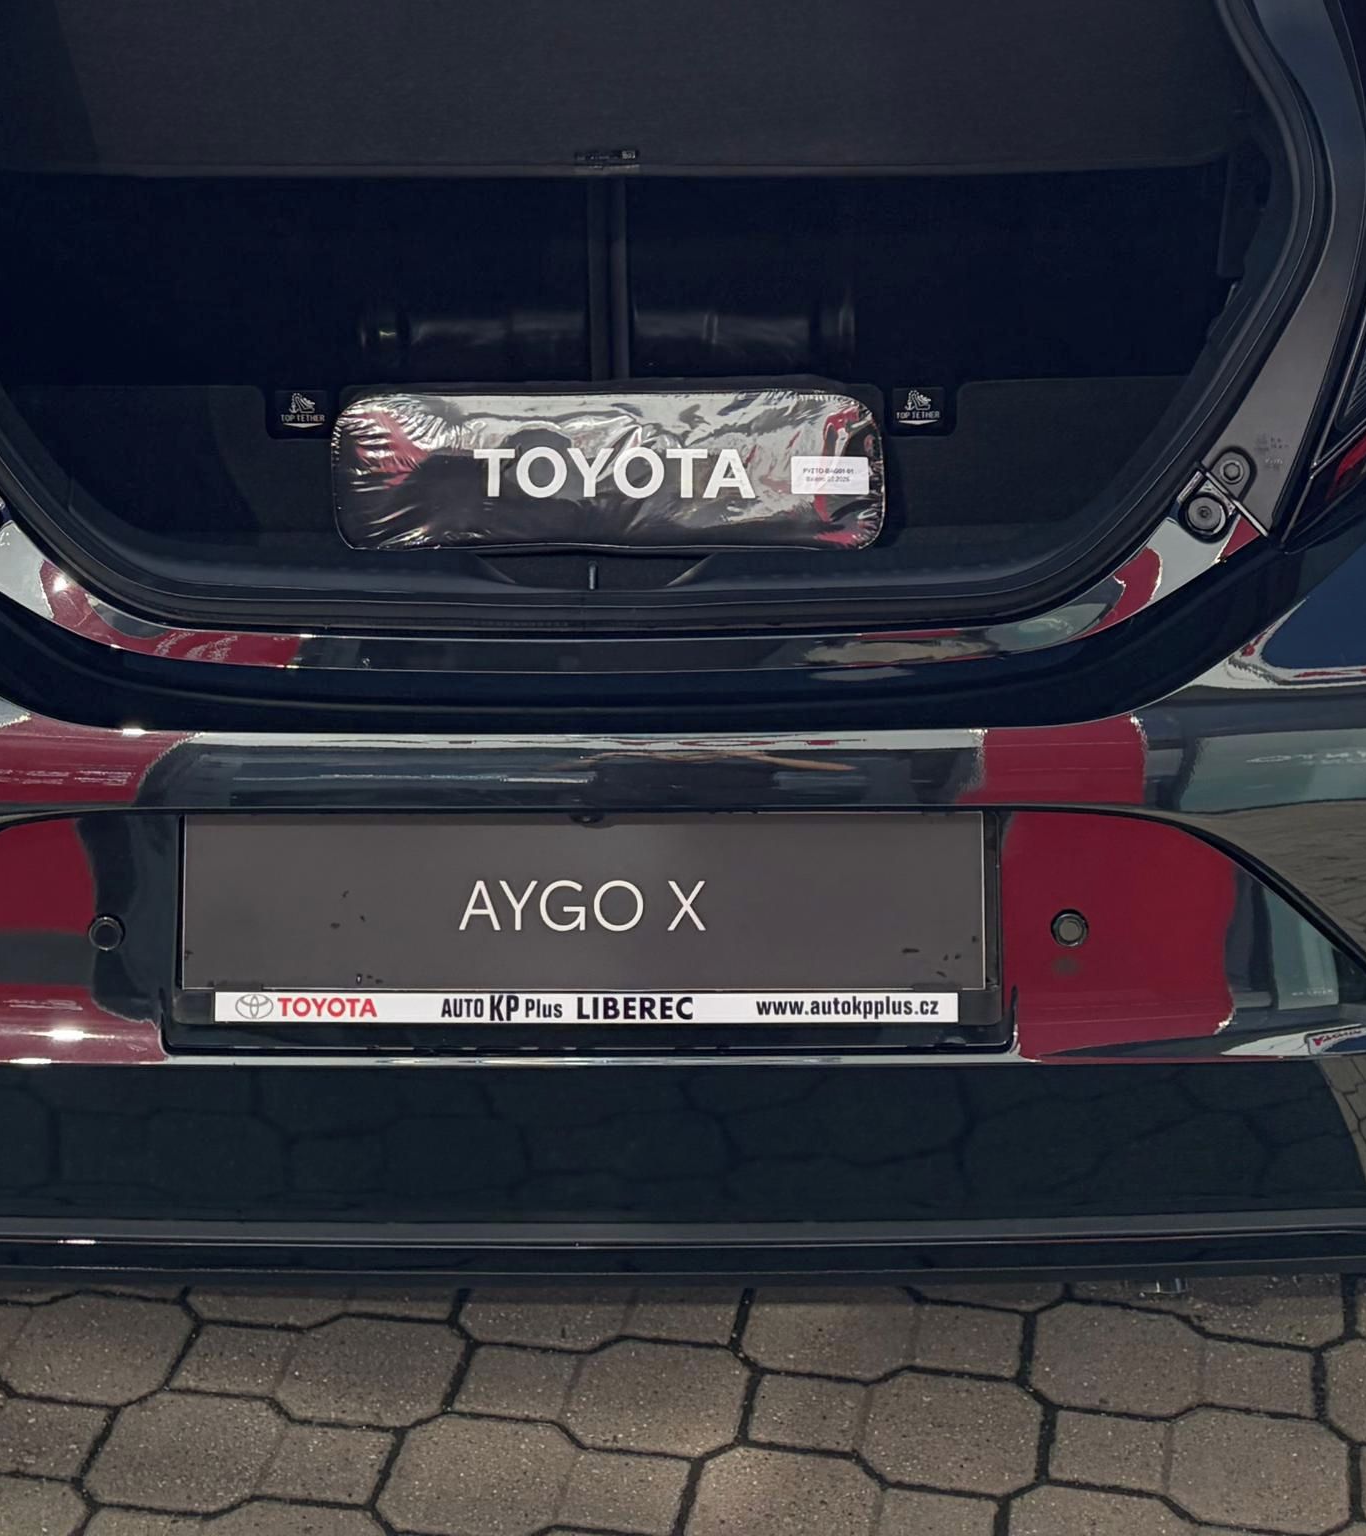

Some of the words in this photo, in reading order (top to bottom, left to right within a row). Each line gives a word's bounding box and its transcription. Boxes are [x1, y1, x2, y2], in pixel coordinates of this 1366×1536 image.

[280, 414, 295, 422] TOP
[297, 414, 325, 422] TETHER
[896, 411, 911, 419] TOP
[912, 410, 940, 419] TETHER
[473, 448, 756, 500] TOYOTA
[458, 880, 644, 932] AYGO
[666, 880, 707, 931] X
[277, 997, 378, 1018] TOYOTA
[441, 998, 484, 1019] AUTO
[489, 995, 520, 1022] KP
[525, 998, 563, 1019] Plus
[576, 997, 694, 1020] LIBEREC
[755, 996, 939, 1020] www.autokpplus.cz
